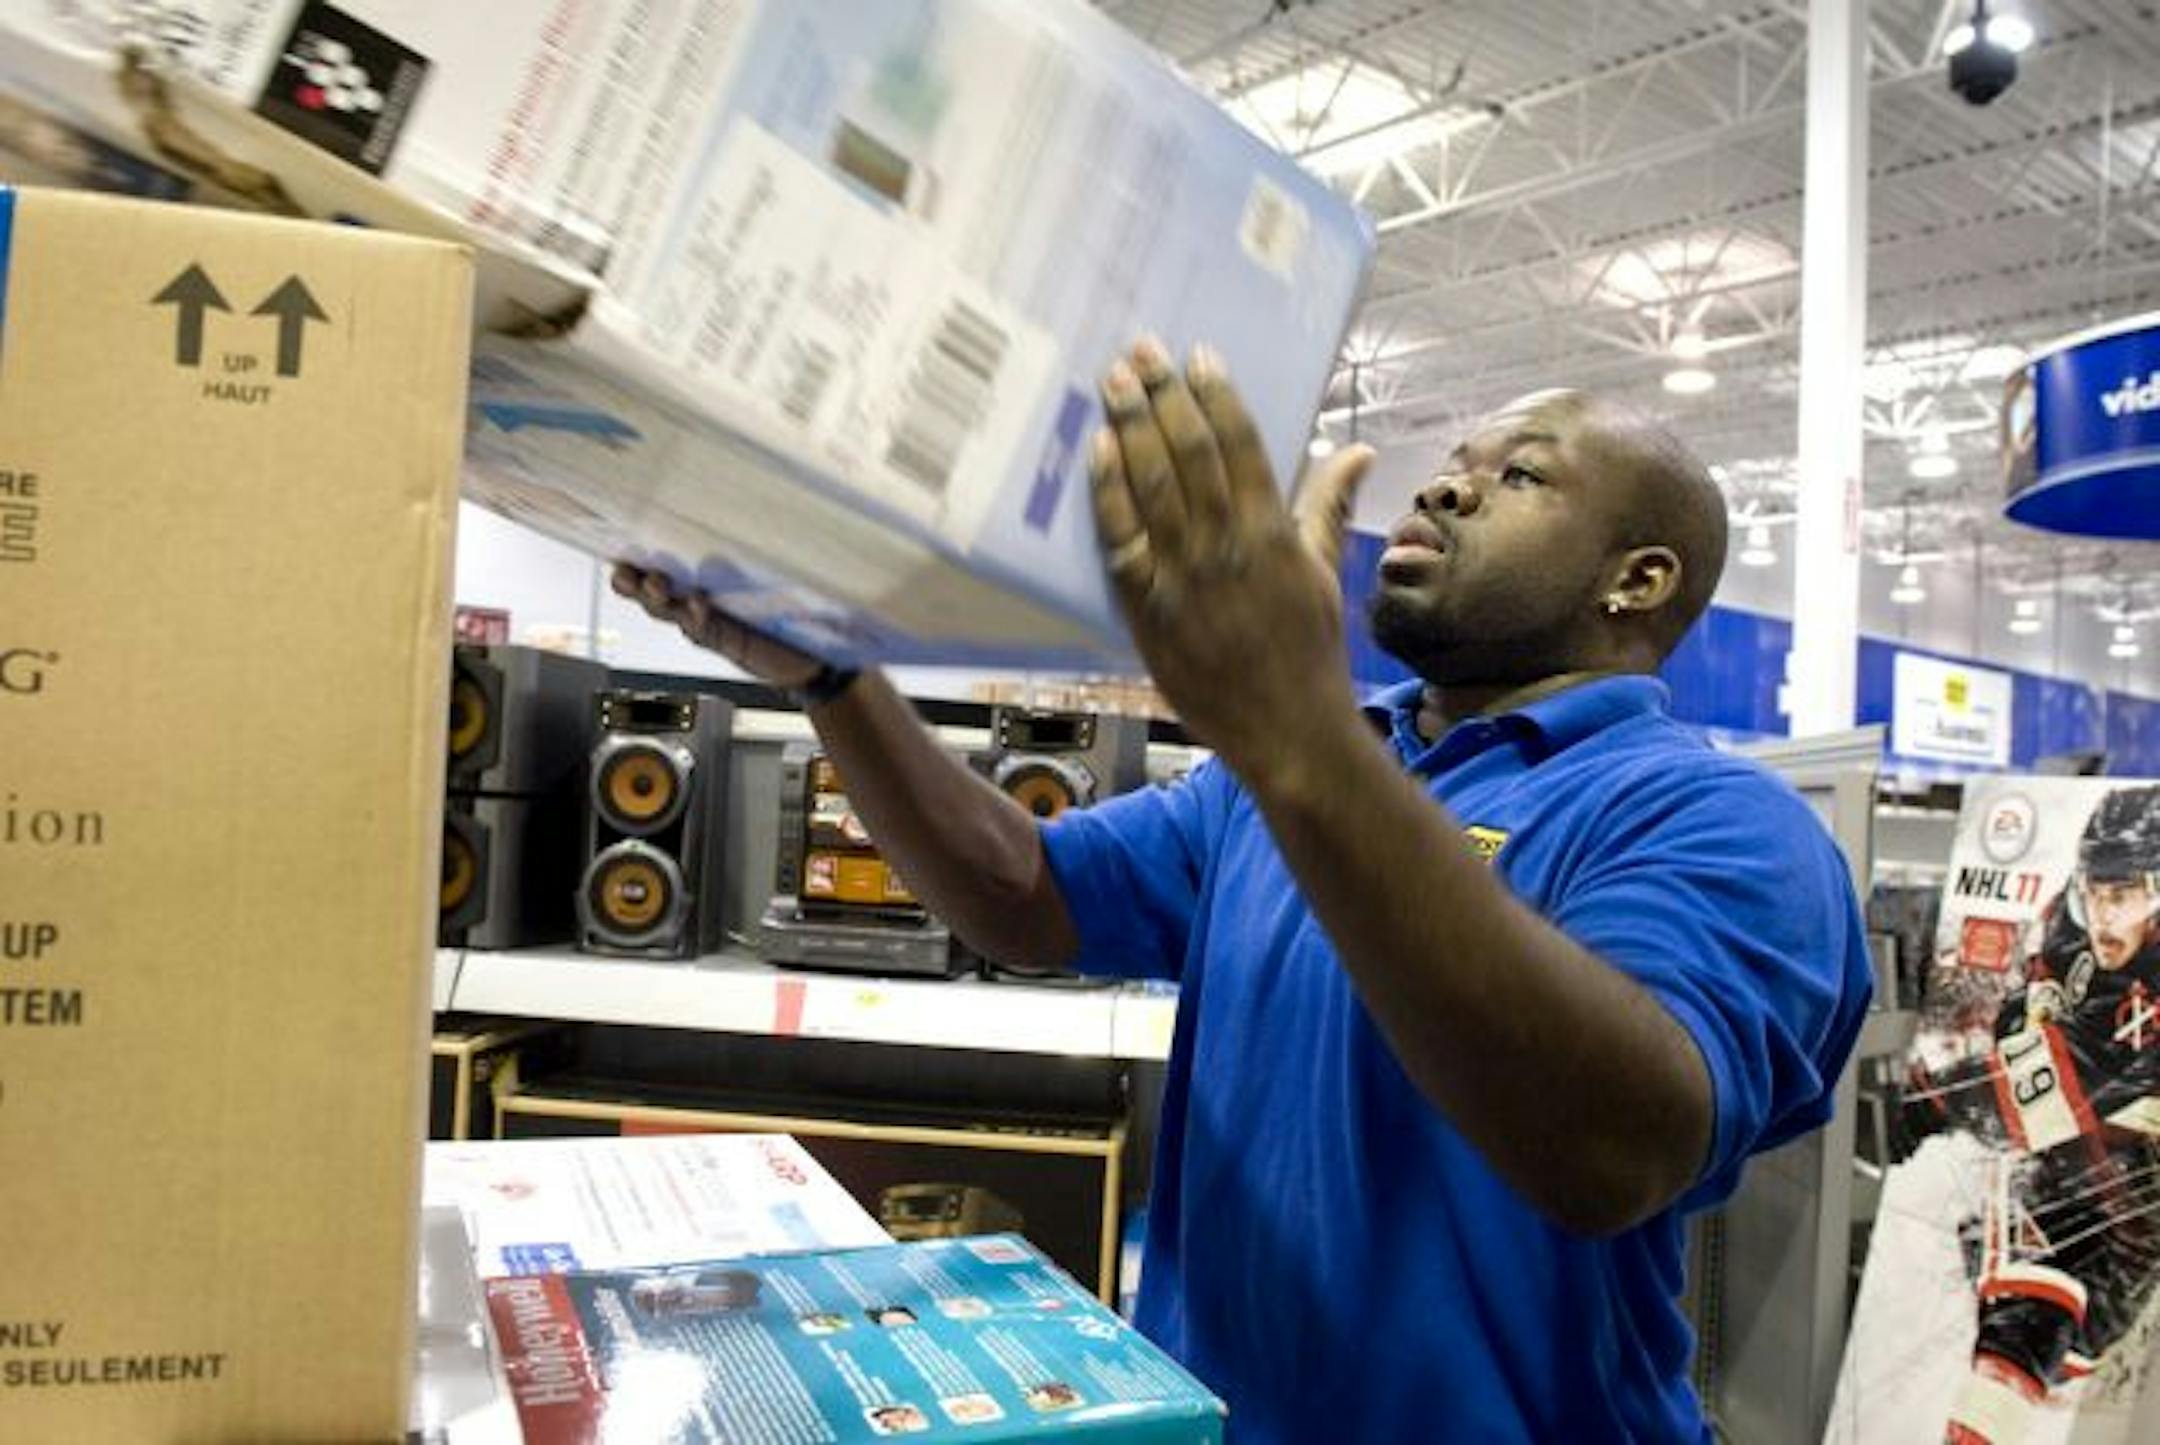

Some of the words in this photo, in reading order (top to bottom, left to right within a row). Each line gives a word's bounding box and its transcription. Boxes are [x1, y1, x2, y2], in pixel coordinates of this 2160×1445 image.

[223, 353, 259, 373] UP
[202, 383, 271, 405] HAUT
[5, 793, 104, 845] ion
[1956, 868, 2009, 900] NHL
[2016, 874, 2043, 904] 11
[3, 922, 60, 960] UP
[0, 989, 83, 1026] TEM
[2004, 1037, 2055, 1105] 19
[0, 1322, 64, 1348] NLY
[2, 1353, 227, 1387] SEULEMENT
